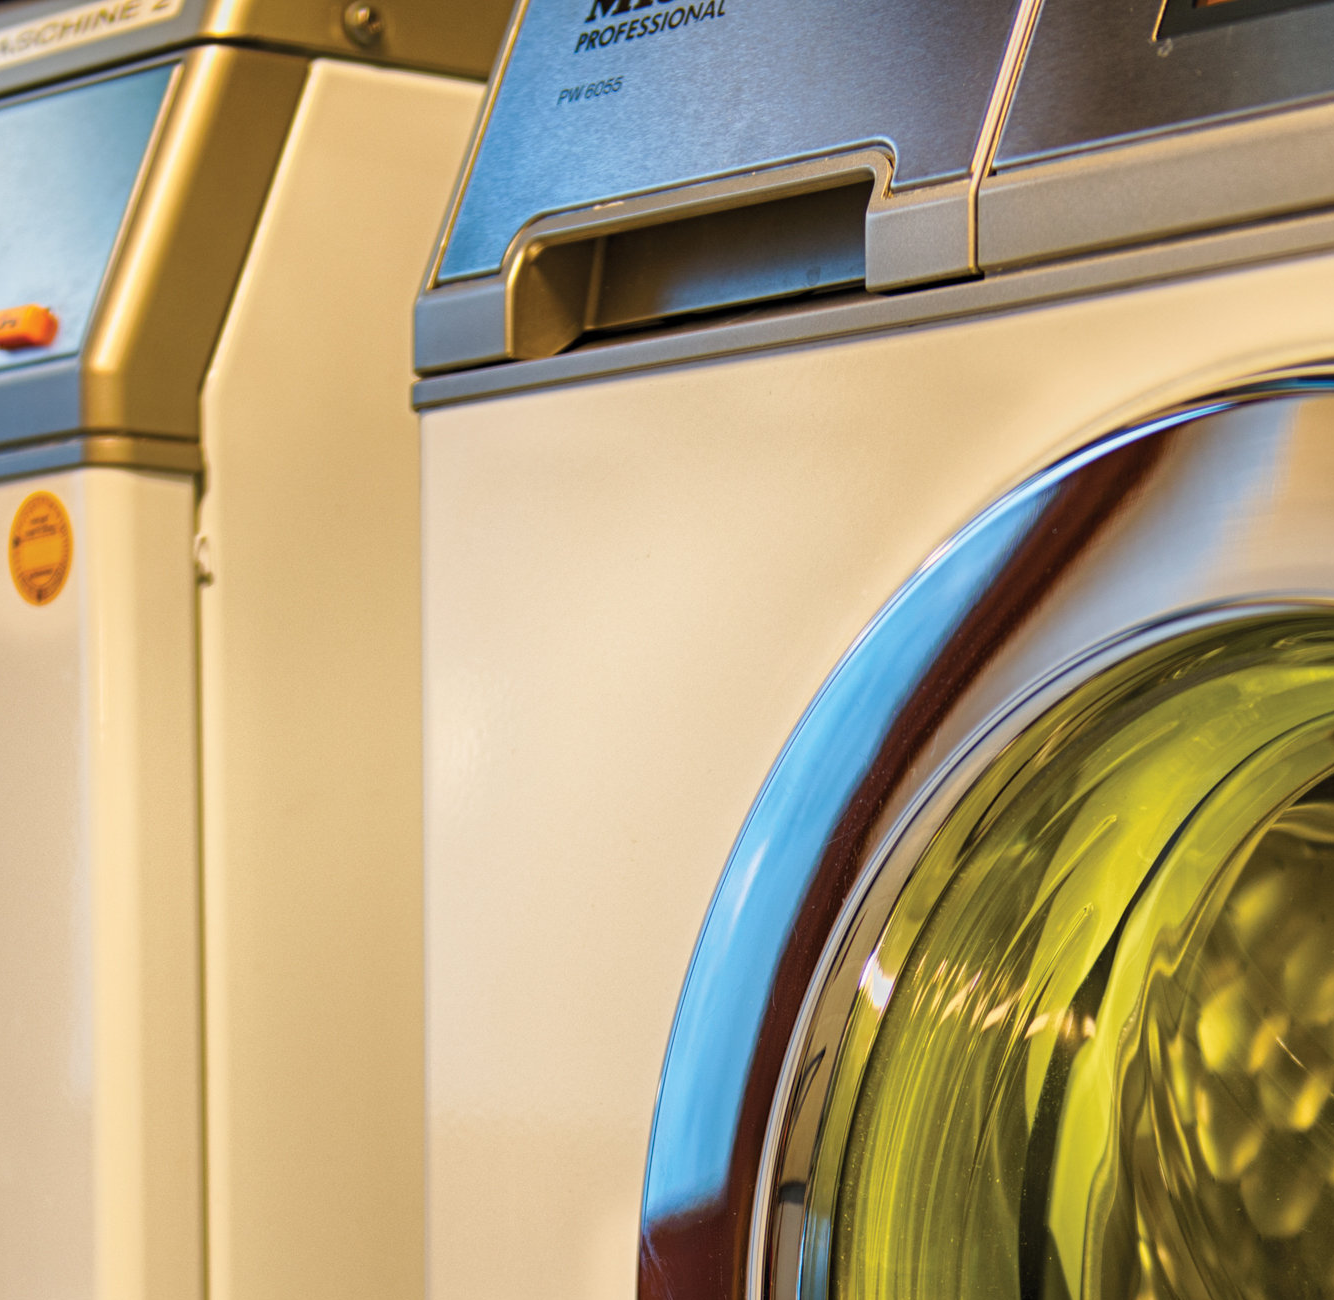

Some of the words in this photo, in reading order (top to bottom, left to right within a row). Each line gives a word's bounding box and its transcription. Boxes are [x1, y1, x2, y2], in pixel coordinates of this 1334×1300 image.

[573, 0, 726, 53] PROFESSIONAL
[556, 84, 586, 106] PW
[584, 75, 624, 99] 6055
